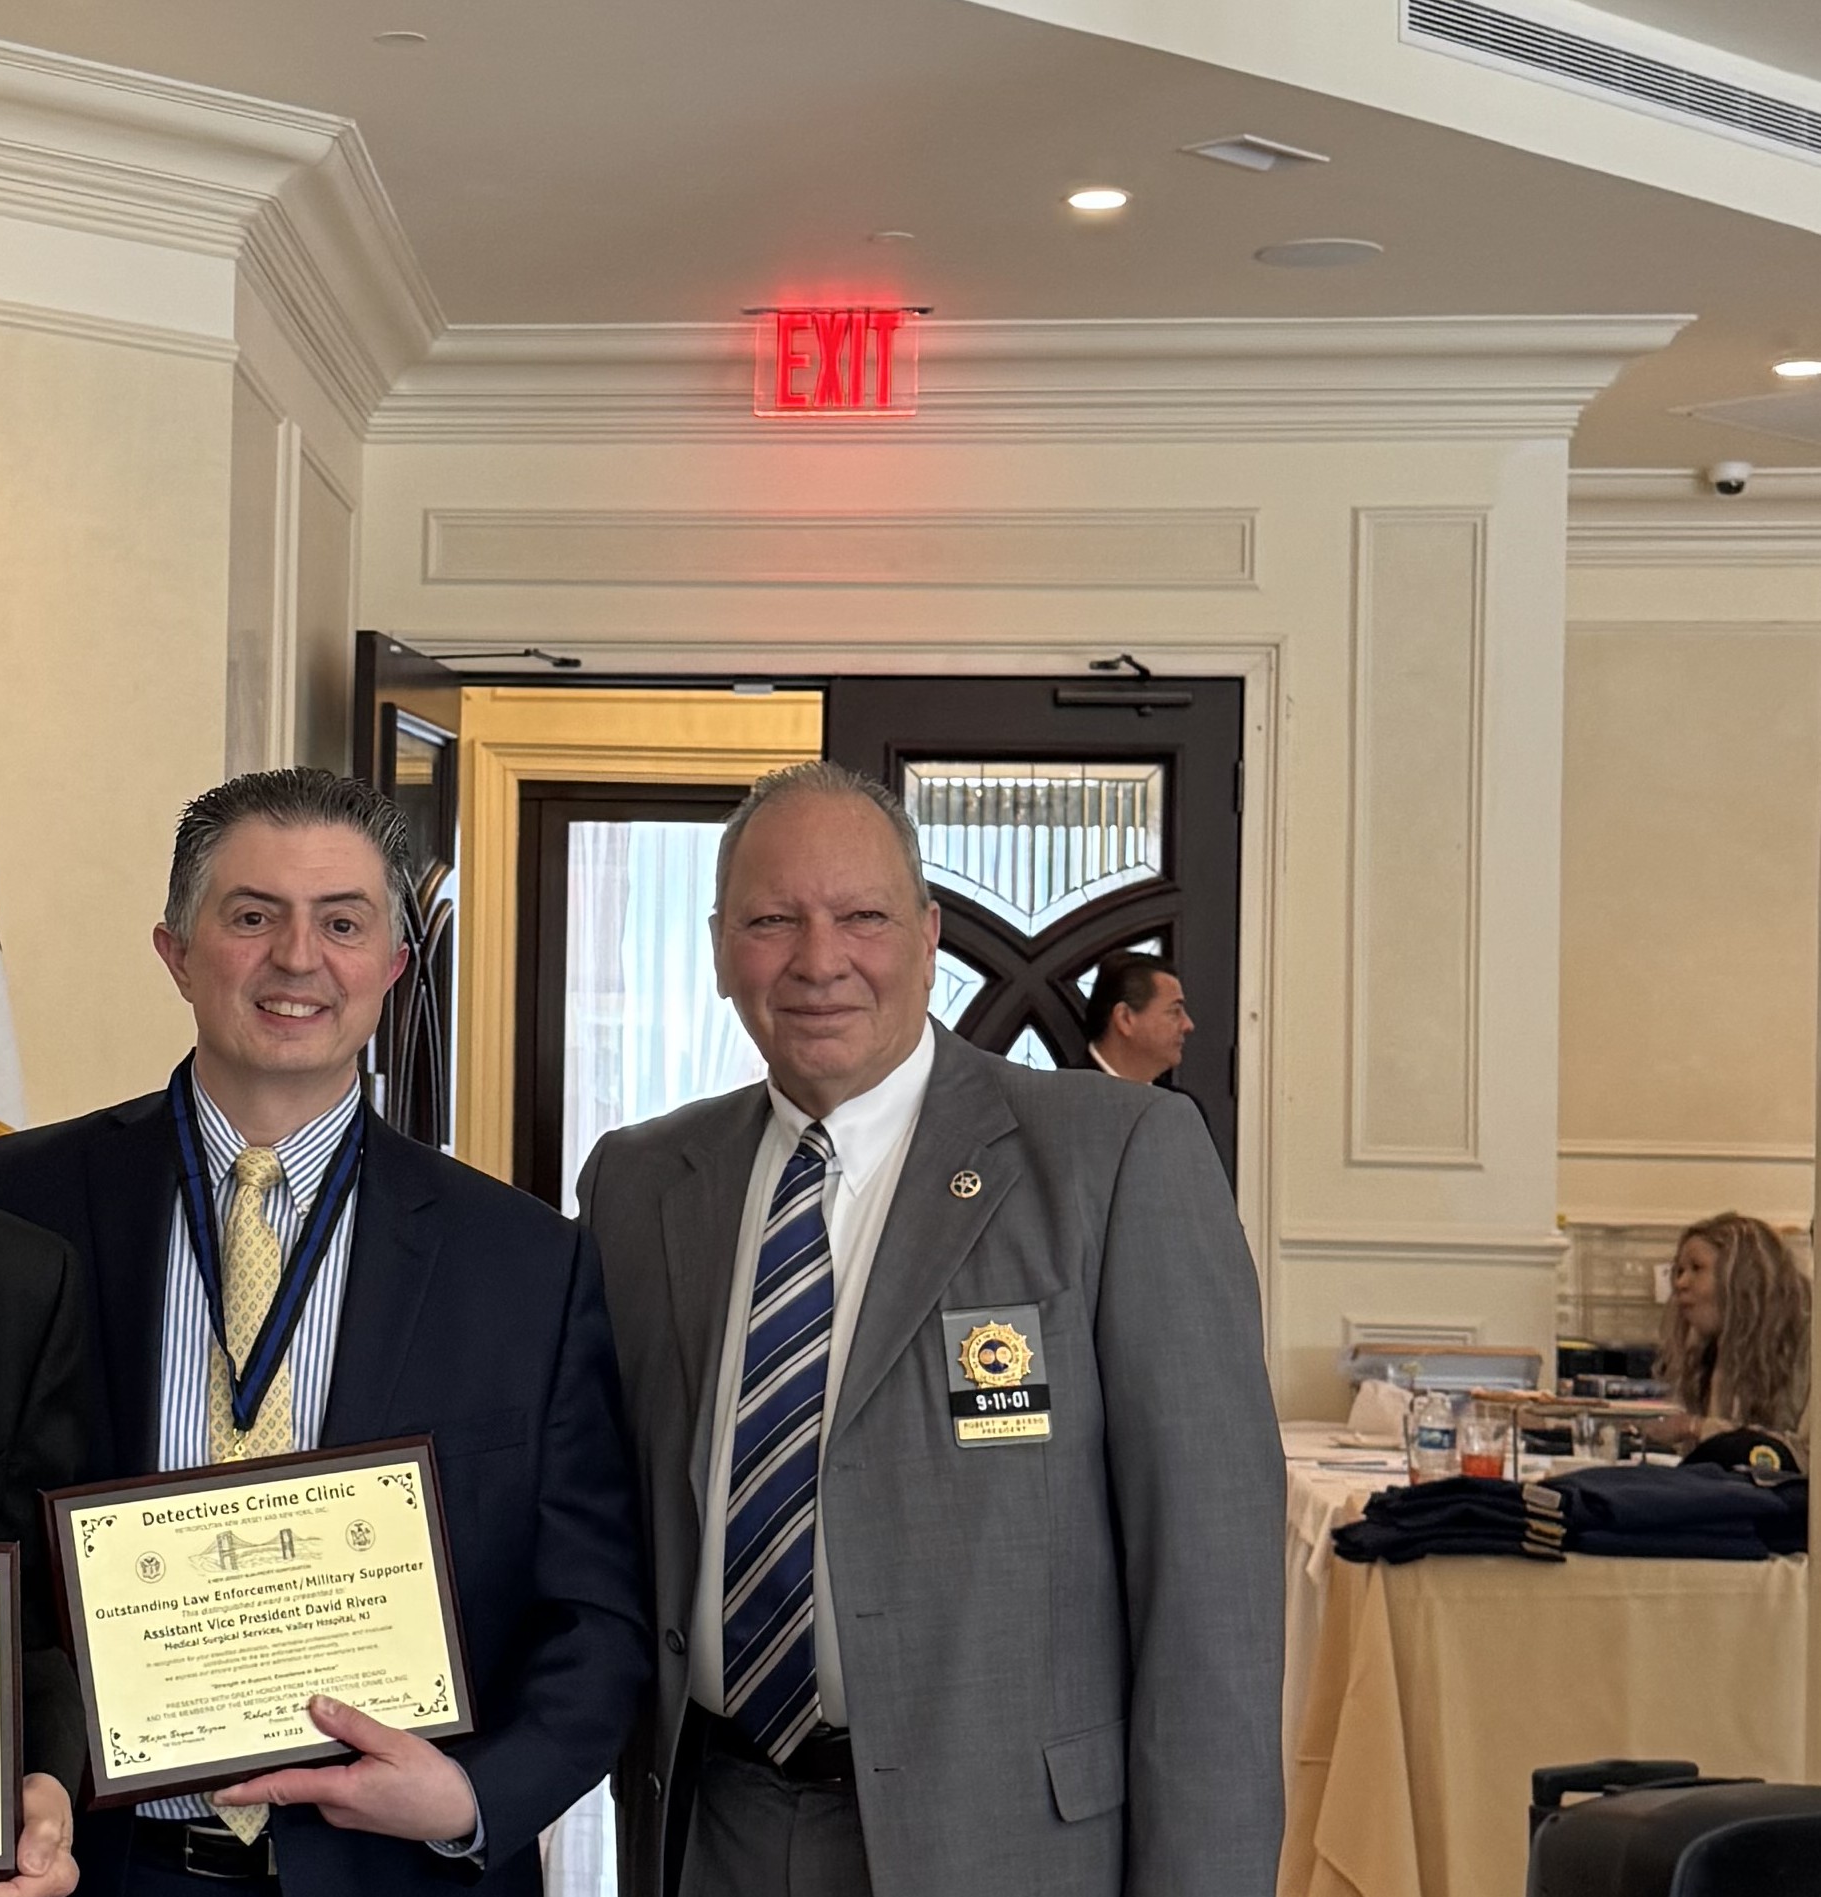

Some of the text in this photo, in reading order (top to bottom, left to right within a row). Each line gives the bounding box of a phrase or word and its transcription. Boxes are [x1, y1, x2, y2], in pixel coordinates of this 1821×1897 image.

[776, 311, 906, 408] EXIT
[142, 1483, 355, 1526] Detectives Crime Clinic
[95, 1599, 178, 1619] Outstanding
[183, 1594, 209, 1606] Law
[214, 1572, 354, 1601] Enforcement/Military
[359, 1562, 423, 1579] Supporter
[143, 1595, 387, 1640] Assistant Vice President David Rivera
[164, 1611, 370, 1650] Medical Surgical Services, Valley Hospital, NJ
